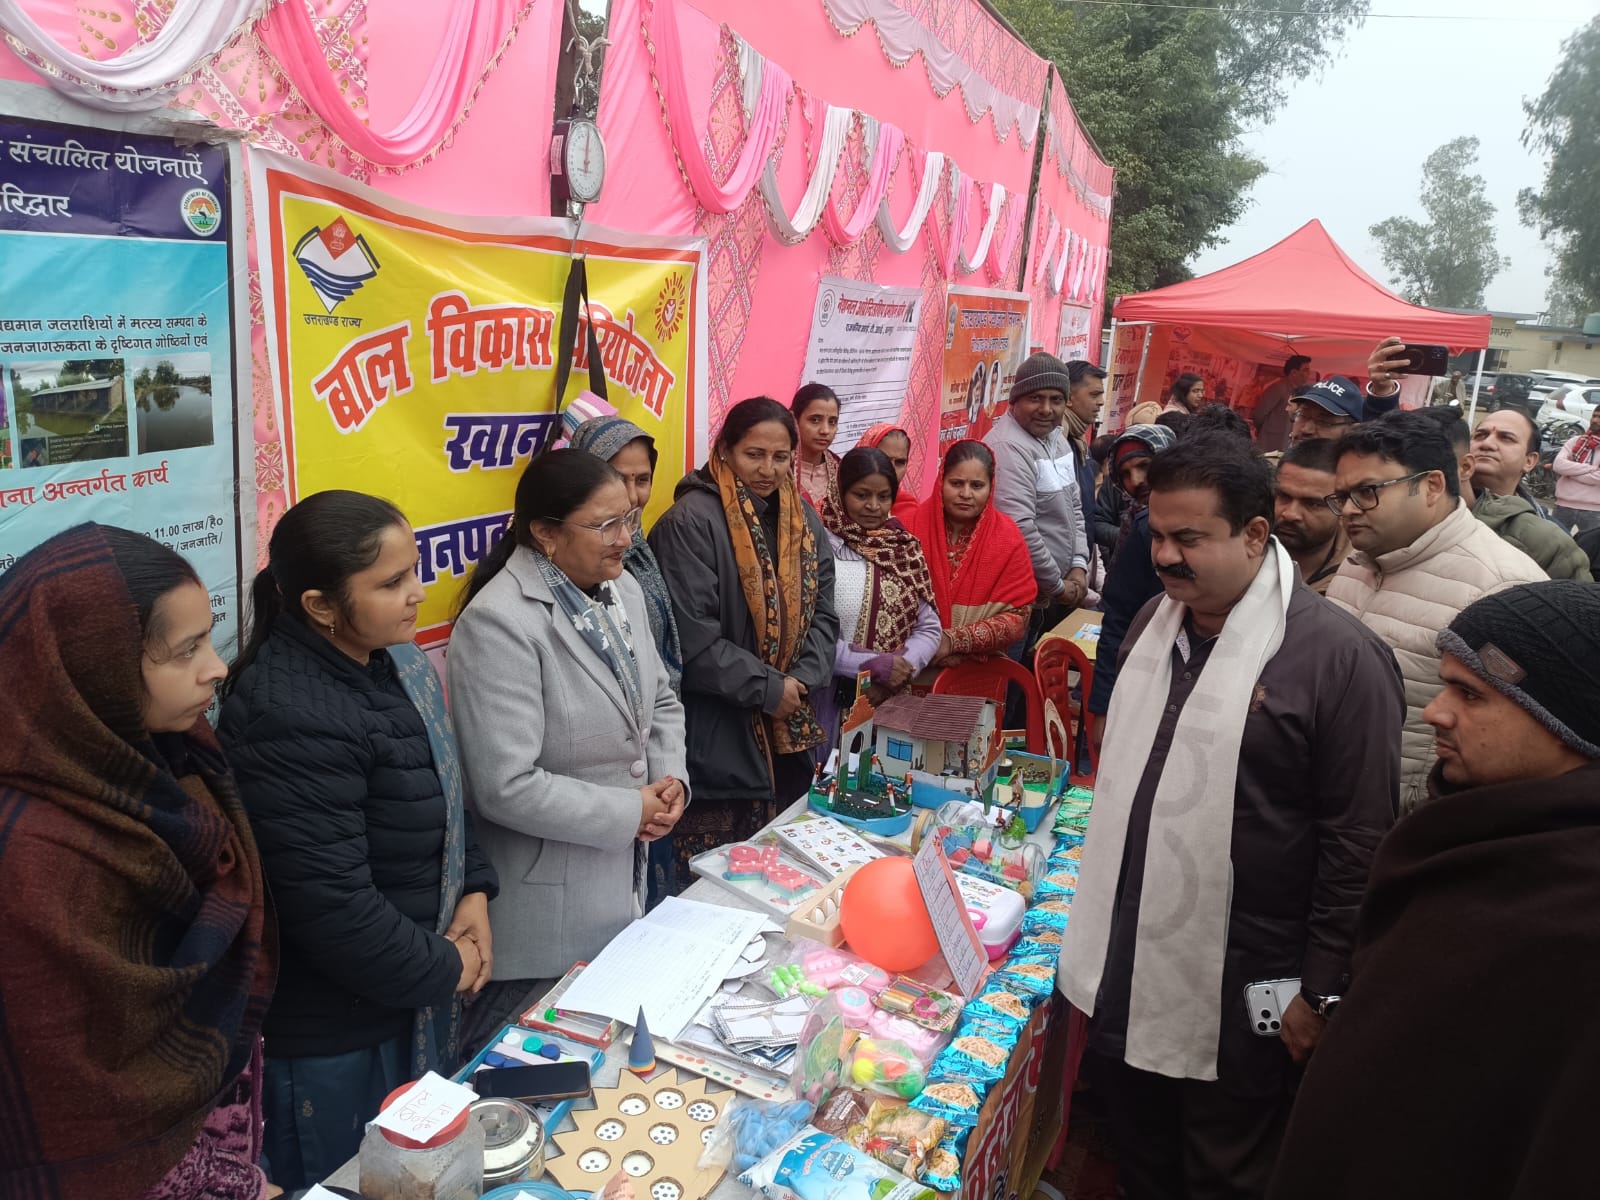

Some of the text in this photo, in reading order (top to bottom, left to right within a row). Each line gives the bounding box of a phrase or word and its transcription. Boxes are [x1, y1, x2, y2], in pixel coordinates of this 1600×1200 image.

[9, 134, 110, 170] संचालित
[0, 183, 72, 217] रिद्वार
[0, 313, 207, 332] द्यमान जलराशियों में मत्स्य सम्पदा के
[303, 314, 363, 328] उत्तराखण्ड राज्य
[0, 339, 92, 354] जनजागरूकता
[95, 335, 107, 350] के
[111, 335, 151, 354] दृष्टिगत
[194, 333, 208, 347] एवं
[313, 322, 412, 432] बाल
[426, 293, 555, 380] विकास
[446, 414, 563, 471] खान
[42, 469, 127, 501] अन्तर्गत
[132, 460, 169, 488] कार्य
[154, 525, 180, 539] 11.00
